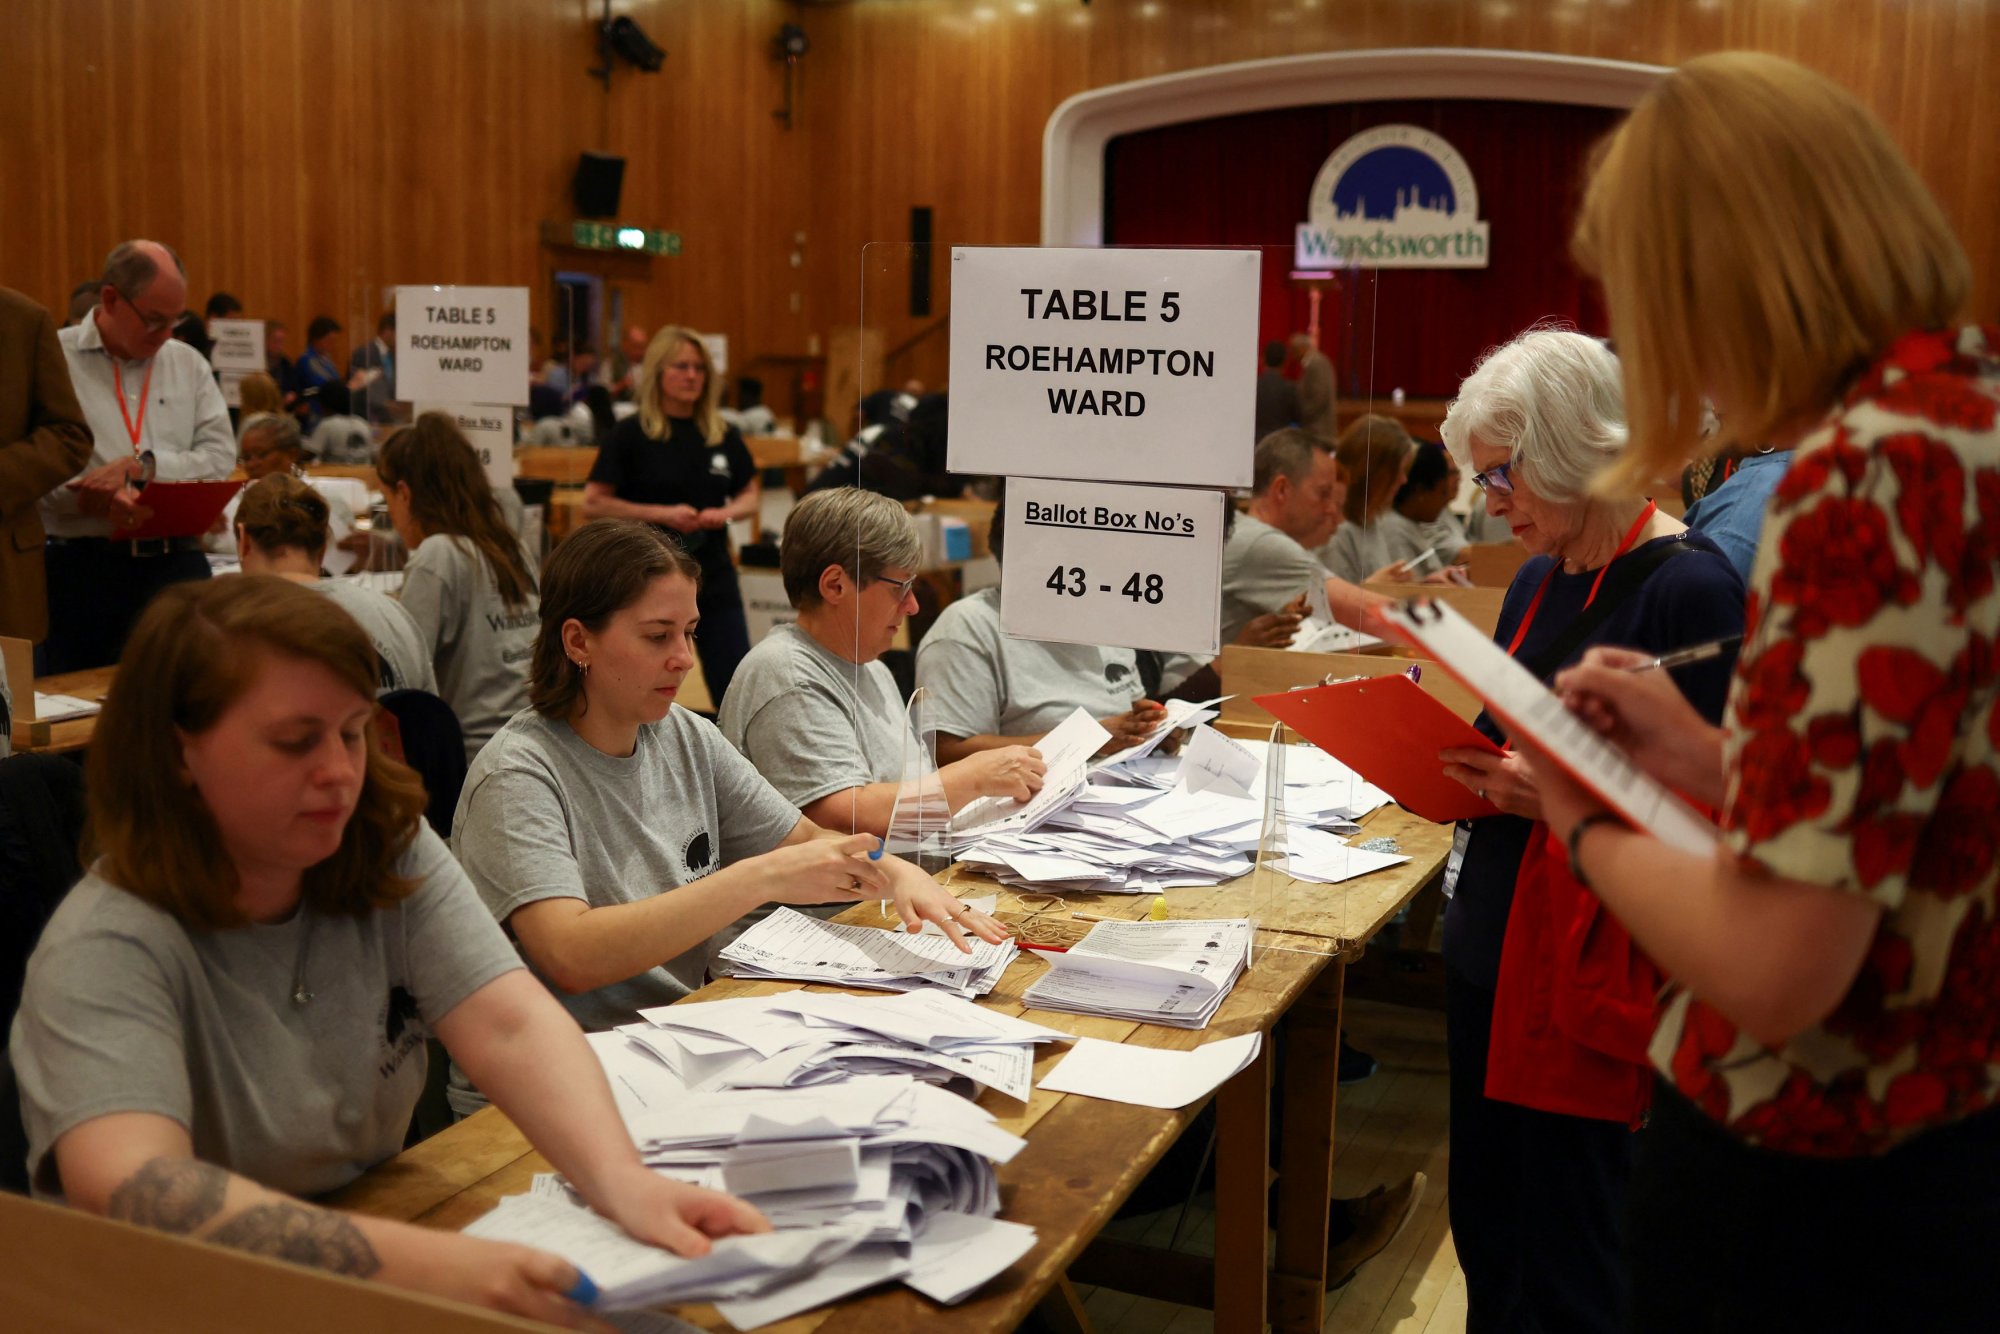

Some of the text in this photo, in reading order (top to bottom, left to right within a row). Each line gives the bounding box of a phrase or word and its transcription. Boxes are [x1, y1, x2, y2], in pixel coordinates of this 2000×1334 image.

[1301, 228, 1485, 260] Wandsworth
[425, 306, 496, 325] TABLE 5
[1020, 288, 1181, 323] TABLE 5
[410, 334, 512, 352] ROEHAMPTON
[438, 356, 484, 372] WARD
[985, 344, 1215, 377] ROEHAMPTON
[1047, 388, 1146, 417] WARD
[1025, 501, 1195, 533] Ballot Box No's
[1046, 565, 1088, 597] 43
[1121, 571, 1165, 605] 48
